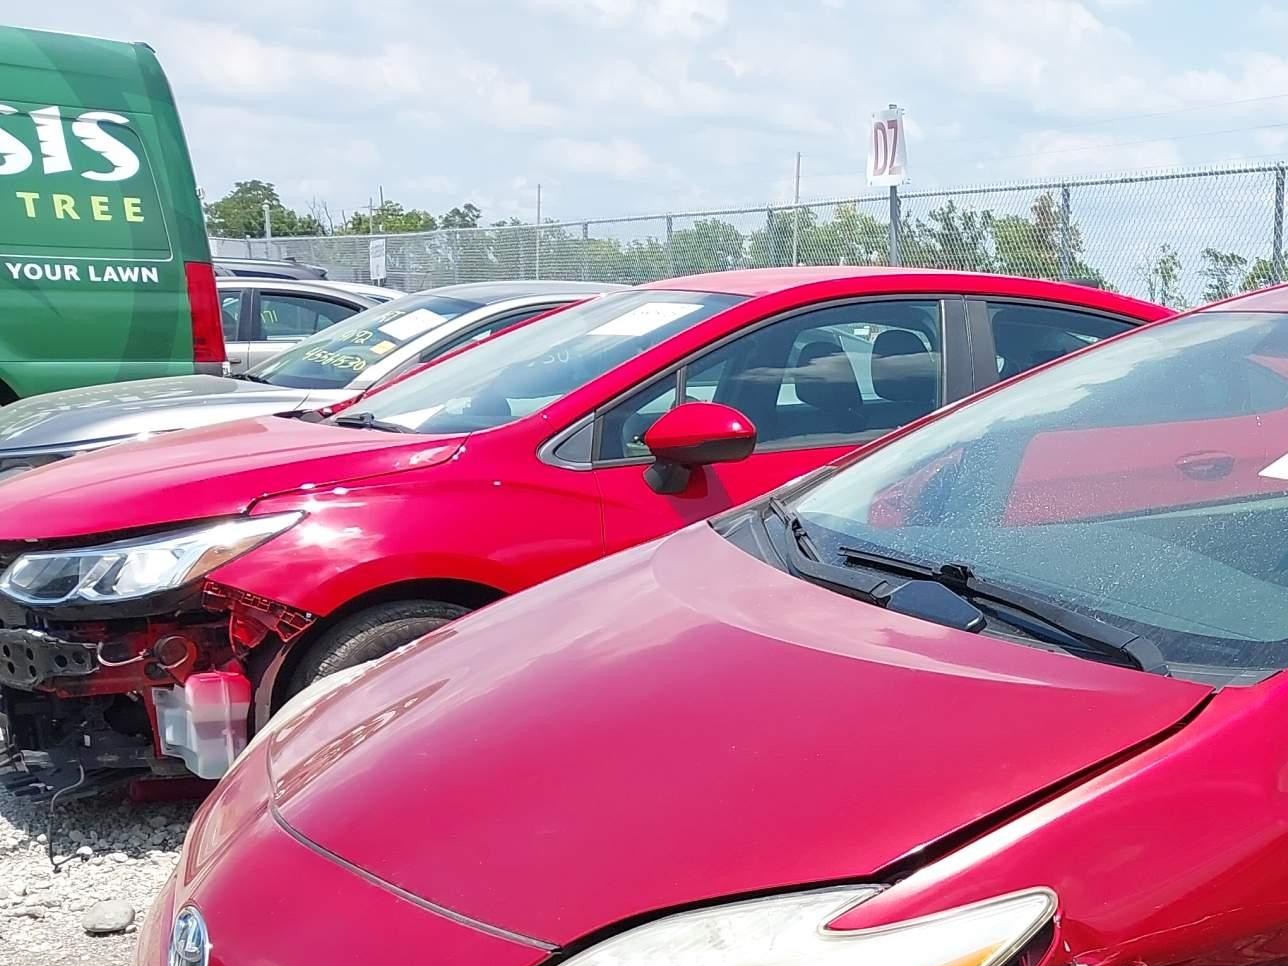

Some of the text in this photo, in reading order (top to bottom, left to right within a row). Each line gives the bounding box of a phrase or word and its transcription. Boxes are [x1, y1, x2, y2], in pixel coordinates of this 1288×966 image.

[16, 191, 145, 222] TREE
[5, 262, 160, 283] YOUR LAWN
